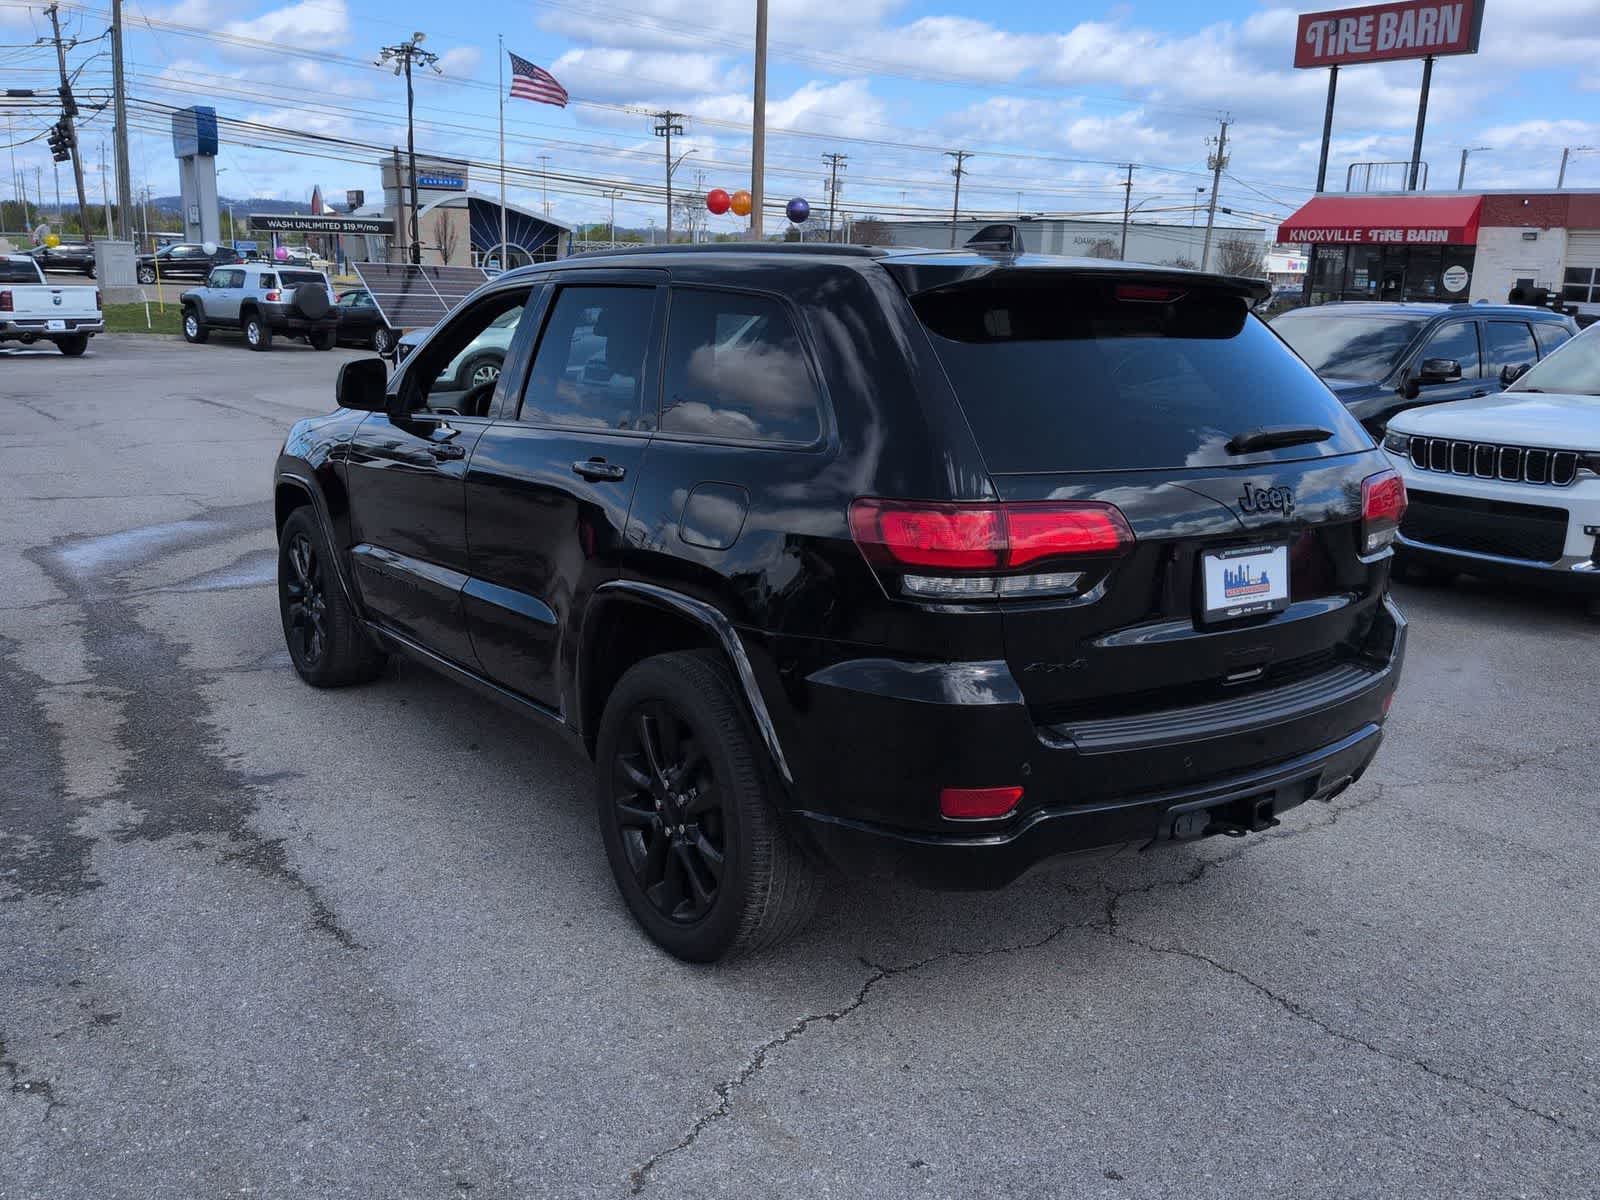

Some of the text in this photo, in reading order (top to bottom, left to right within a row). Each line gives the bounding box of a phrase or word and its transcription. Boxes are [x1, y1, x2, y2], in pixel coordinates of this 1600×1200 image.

[1376, 3, 1464, 52] BARN
[267, 220, 293, 228] WASH
[295, 221, 341, 230] UNLIMITED
[1289, 229, 1362, 242] KNOXVILLE
[1406, 229, 1449, 242] BARN
[1239, 482, 1296, 519] Jeep
